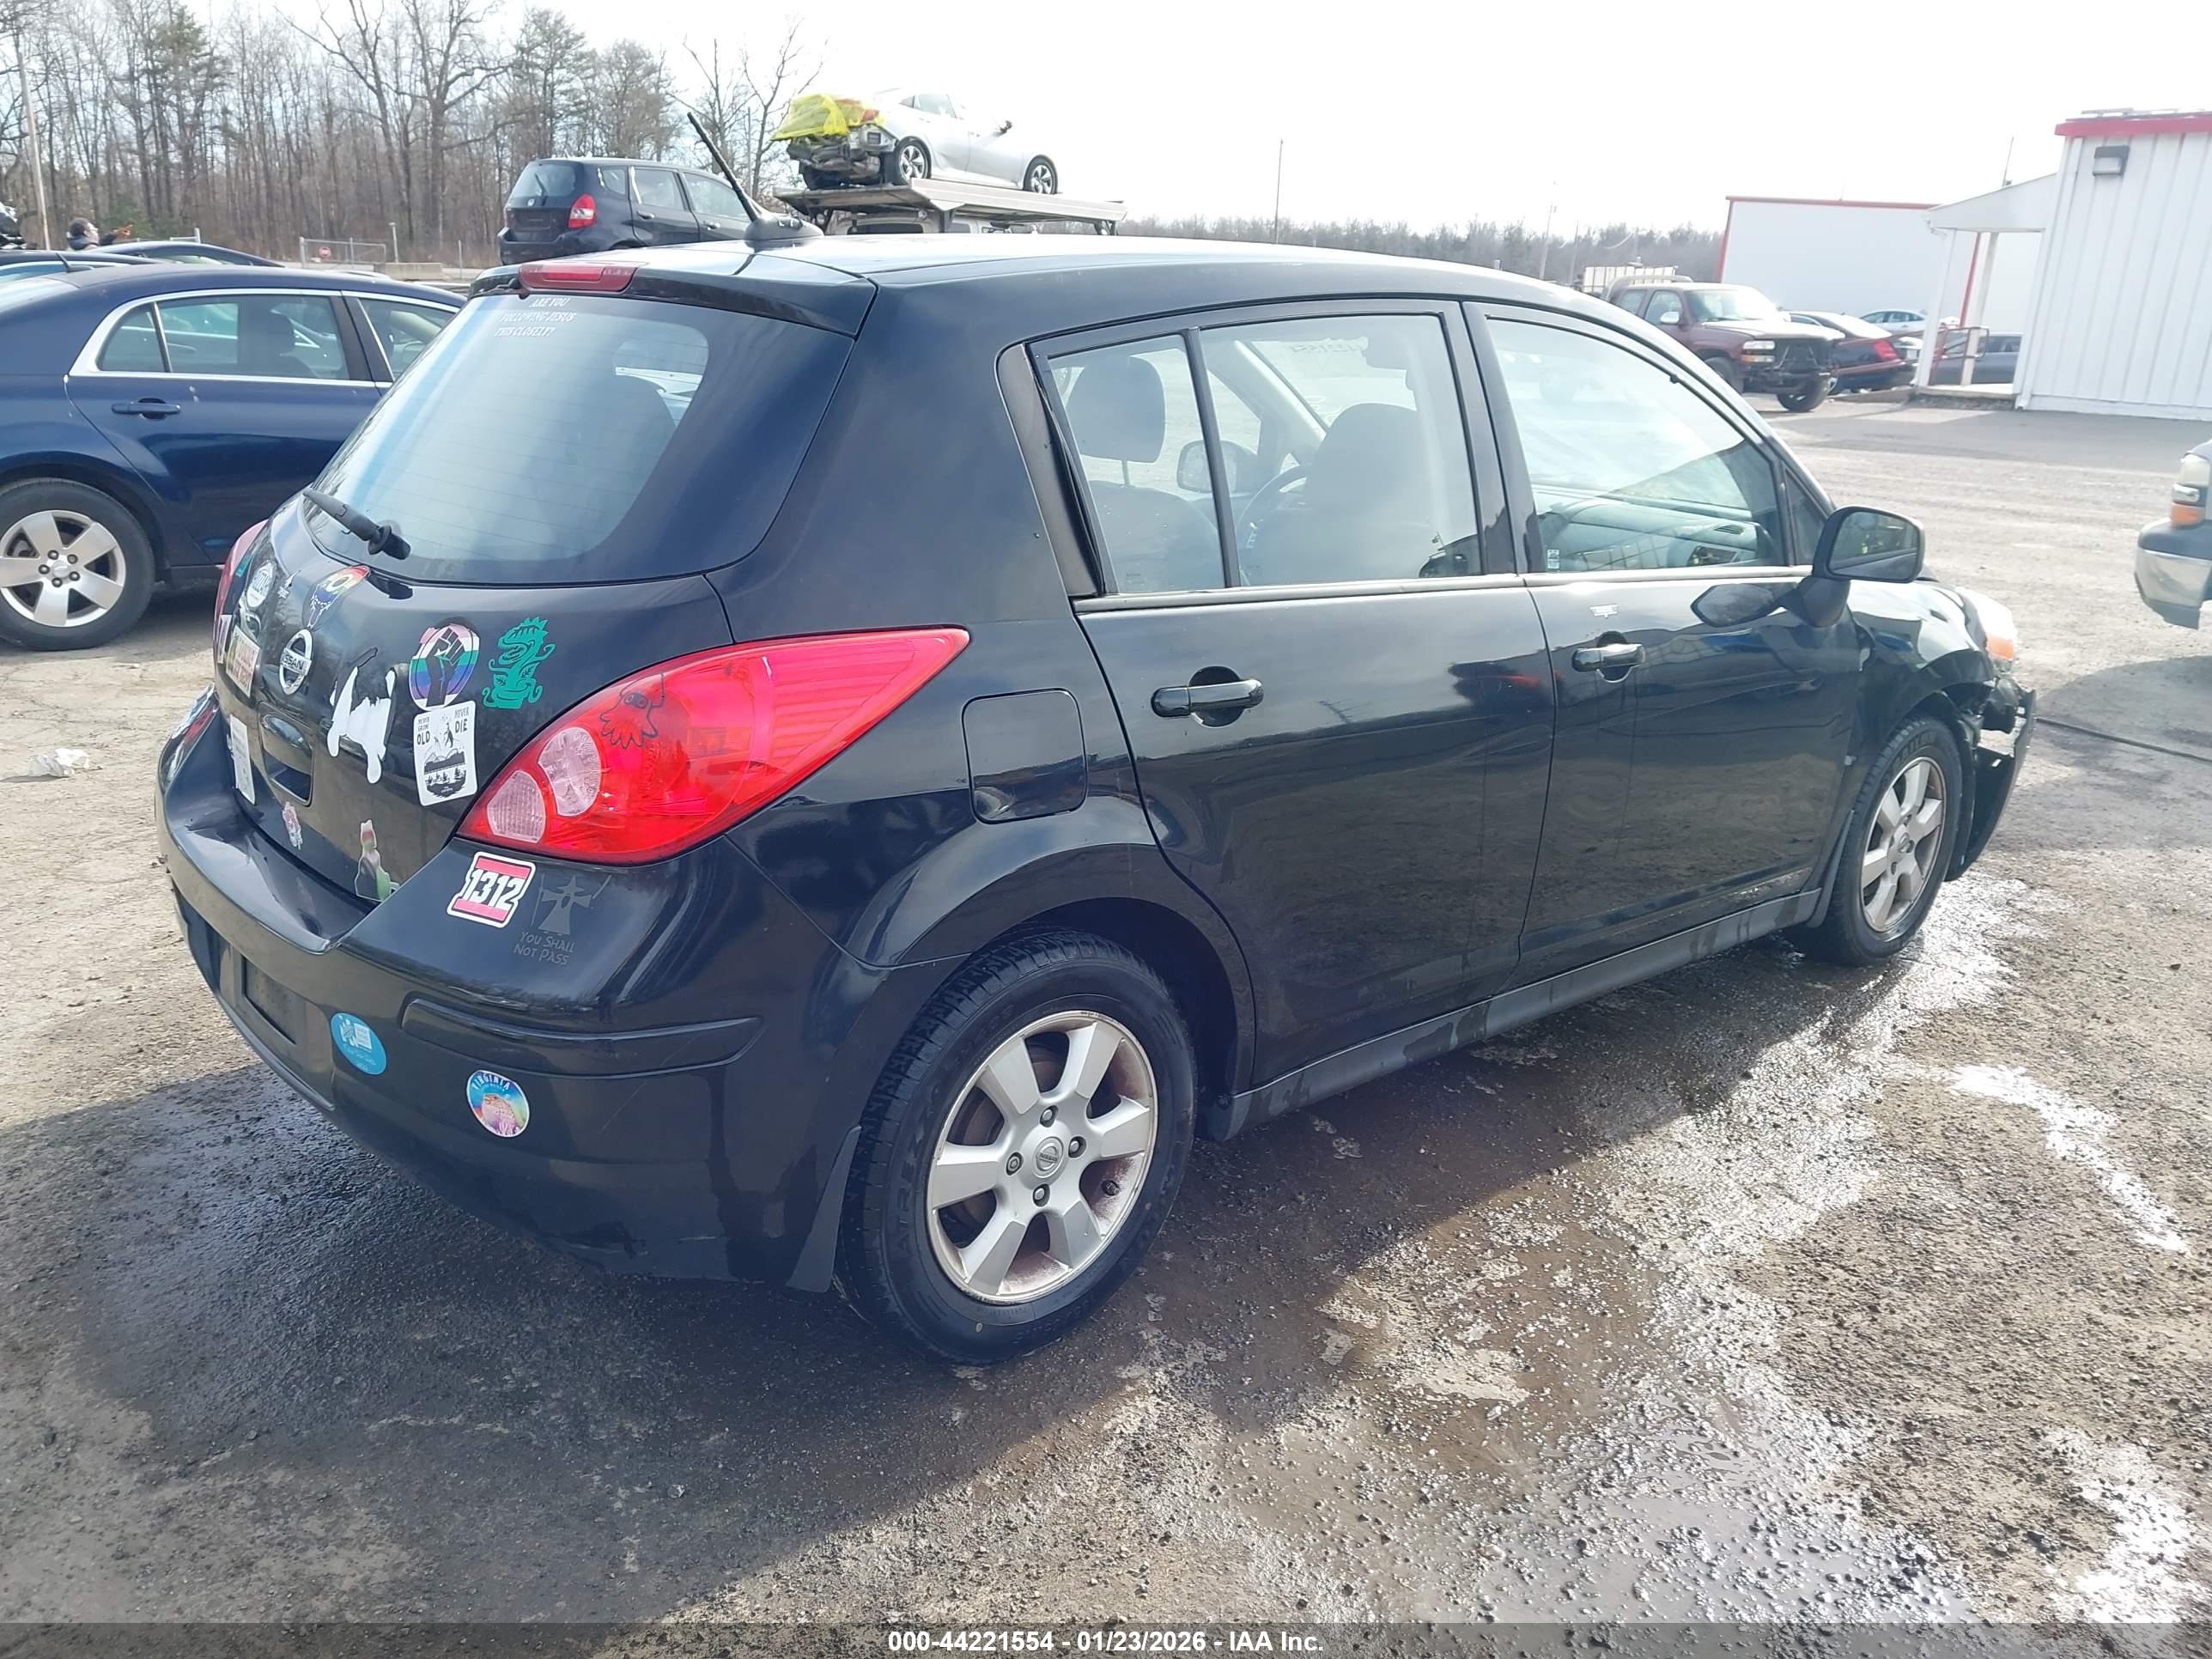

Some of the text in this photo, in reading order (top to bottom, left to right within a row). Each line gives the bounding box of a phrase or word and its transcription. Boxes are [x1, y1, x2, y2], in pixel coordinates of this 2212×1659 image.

[549, 297, 571, 307] YOU
[548, 311, 577, 322] JESUS
[455, 719, 467, 733] DIE
[417, 731, 430, 745] OLD
[462, 869, 526, 911] 1312
[520, 931, 575, 952] YOU SHALL
[514, 944, 569, 964] NOT PASS
[471, 1073, 510, 1091] VIRGINIA
